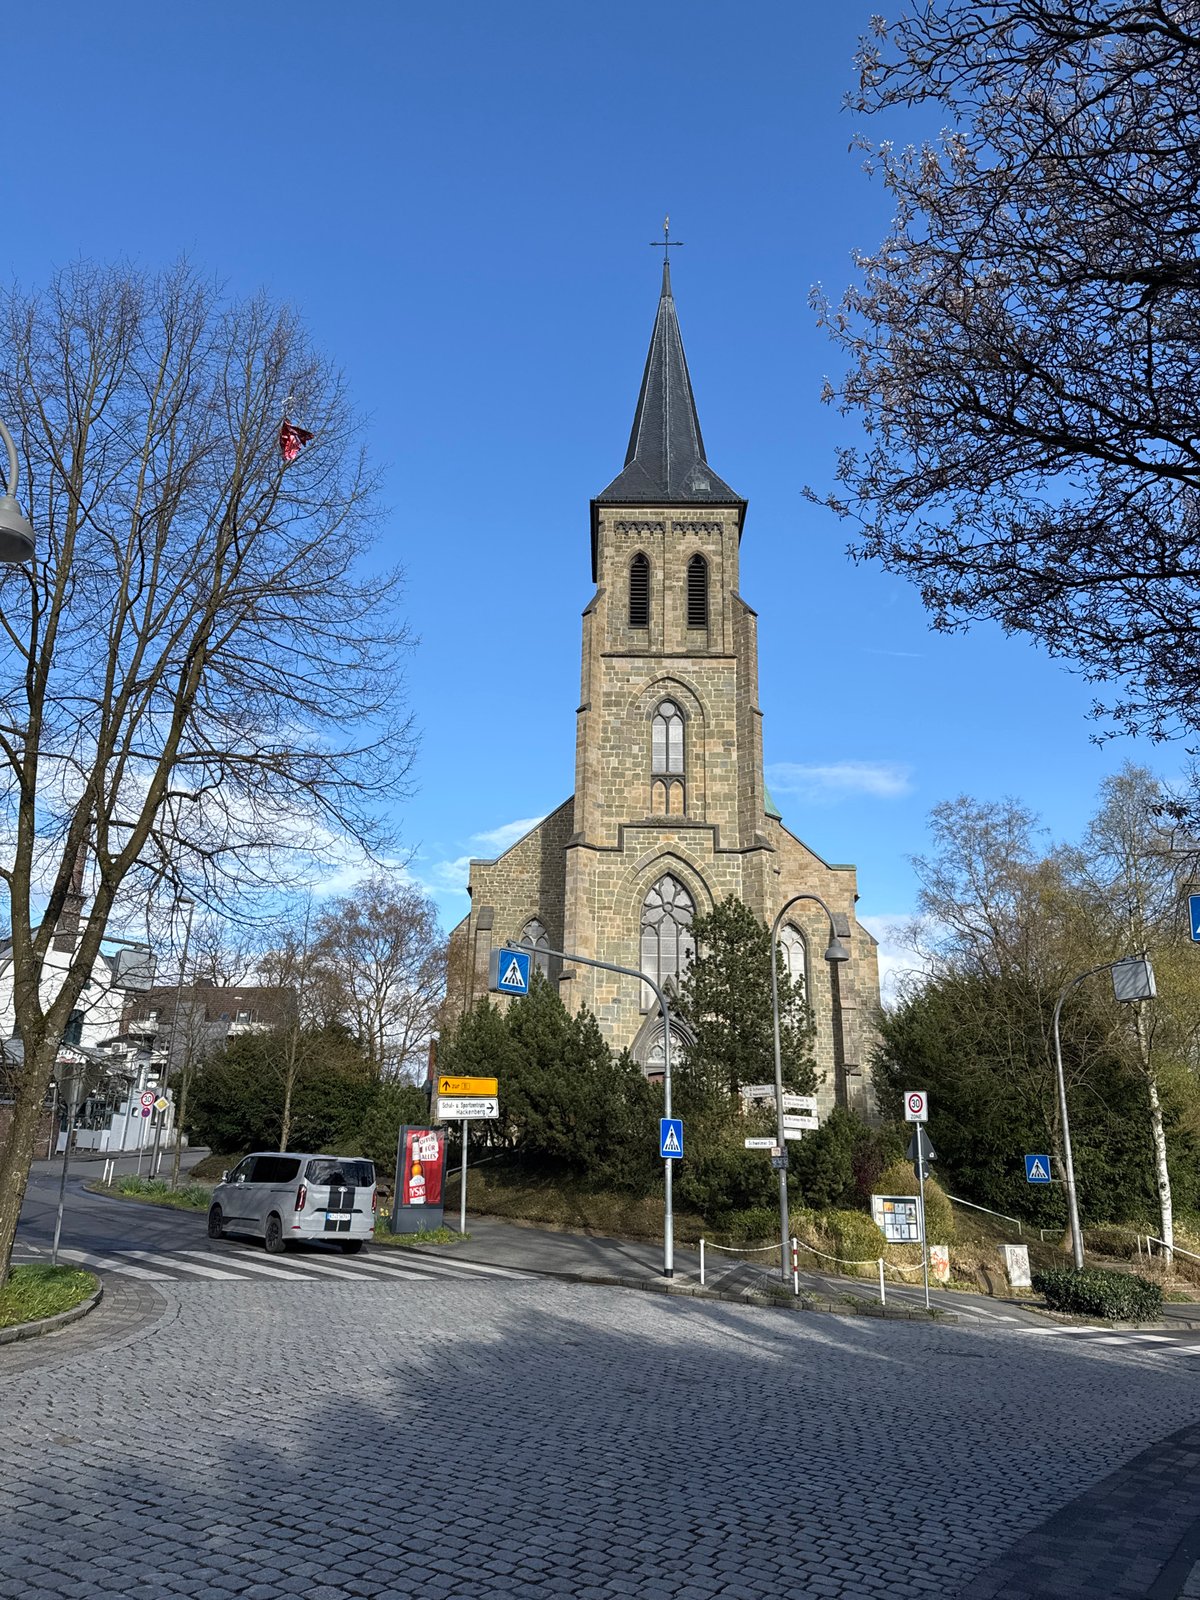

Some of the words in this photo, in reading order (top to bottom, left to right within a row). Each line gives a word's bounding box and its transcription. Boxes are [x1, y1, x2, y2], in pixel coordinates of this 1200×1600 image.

[143, 1095, 152, 1103] 30
[912, 1098, 920, 1108] 30
[425, 1144, 435, 1152] FÜR
